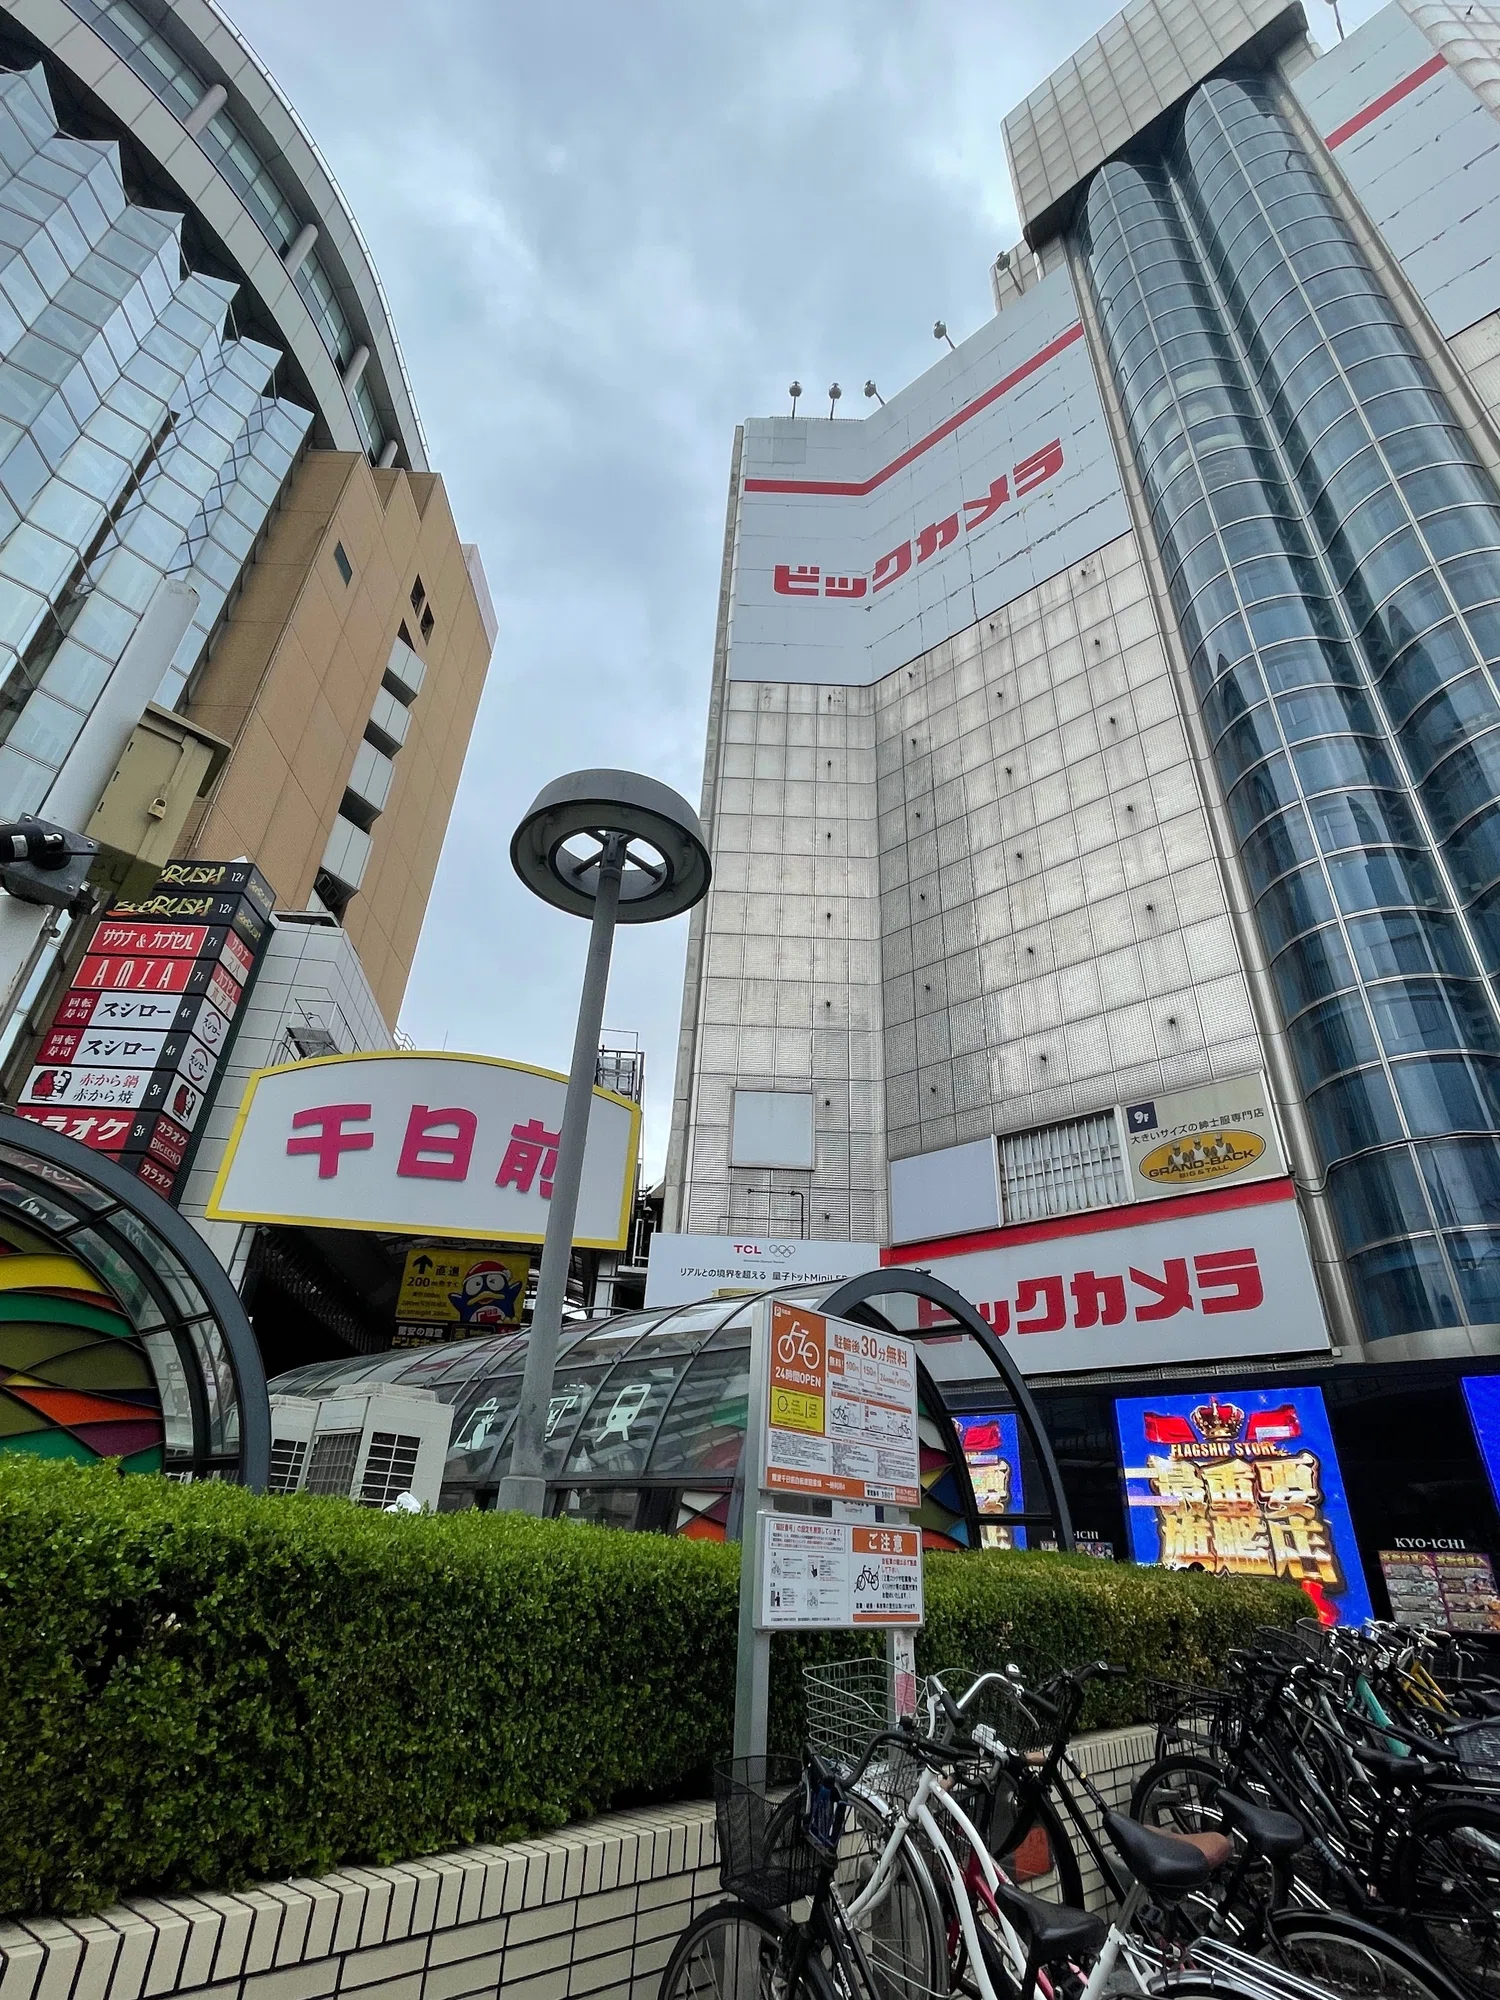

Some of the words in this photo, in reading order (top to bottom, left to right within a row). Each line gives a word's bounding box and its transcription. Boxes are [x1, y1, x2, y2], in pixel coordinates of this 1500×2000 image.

[773, 437, 1064, 598] ビックカメラ
[160, 864, 226, 886] RUSH
[231, 872, 245, 882] 12F
[218, 903, 233, 913] 12F
[207, 937, 218, 947] 7F
[92, 960, 175, 988] AMZA
[194, 971, 205, 981] 7F
[68, 997, 93, 1008] 回転
[98, 1002, 171, 1018] スシロー
[63, 1008, 88, 1019] 寿司
[180, 1008, 191, 1019] 4F
[202, 1017, 221, 1037] スシロー
[51, 1034, 76, 1046] 回転
[80, 1039, 156, 1056] スシロー
[47, 1045, 72, 1057] 寿司
[165, 1045, 176, 1056] 4F
[188, 1054, 208, 1074] スシロー
[79, 1073, 140, 1088] 赤から鍋
[72, 1089, 135, 1104] 赤から焼
[150, 1084, 162, 1096] 3F
[1133, 1111, 1149, 1124] 9F
[133, 1125, 146, 1137] 3F
[1130, 1107, 1265, 1144] 大きいサイズの紳士服専門店
[158, 1121, 188, 1146] カラオケ
[286, 1103, 560, 1200] 千日前
[1148, 1149, 1256, 1178] GRAND-BACK
[141, 1164, 173, 1188] カラオケ
[1179, 1170, 1196, 1178] BIG
[1204, 1165, 1229, 1173] TALL
[733, 1244, 762, 1254] TCL
[680, 1267, 767, 1280] リアルとの境界を超える
[772, 1271, 847, 1282] 量子ドットMiniL
[1171, 1443, 1231, 1459] FLAGSHIP
[868, 1533, 904, 1553] ご注意
[1394, 1537, 1466, 1550] KYO-ICHI
